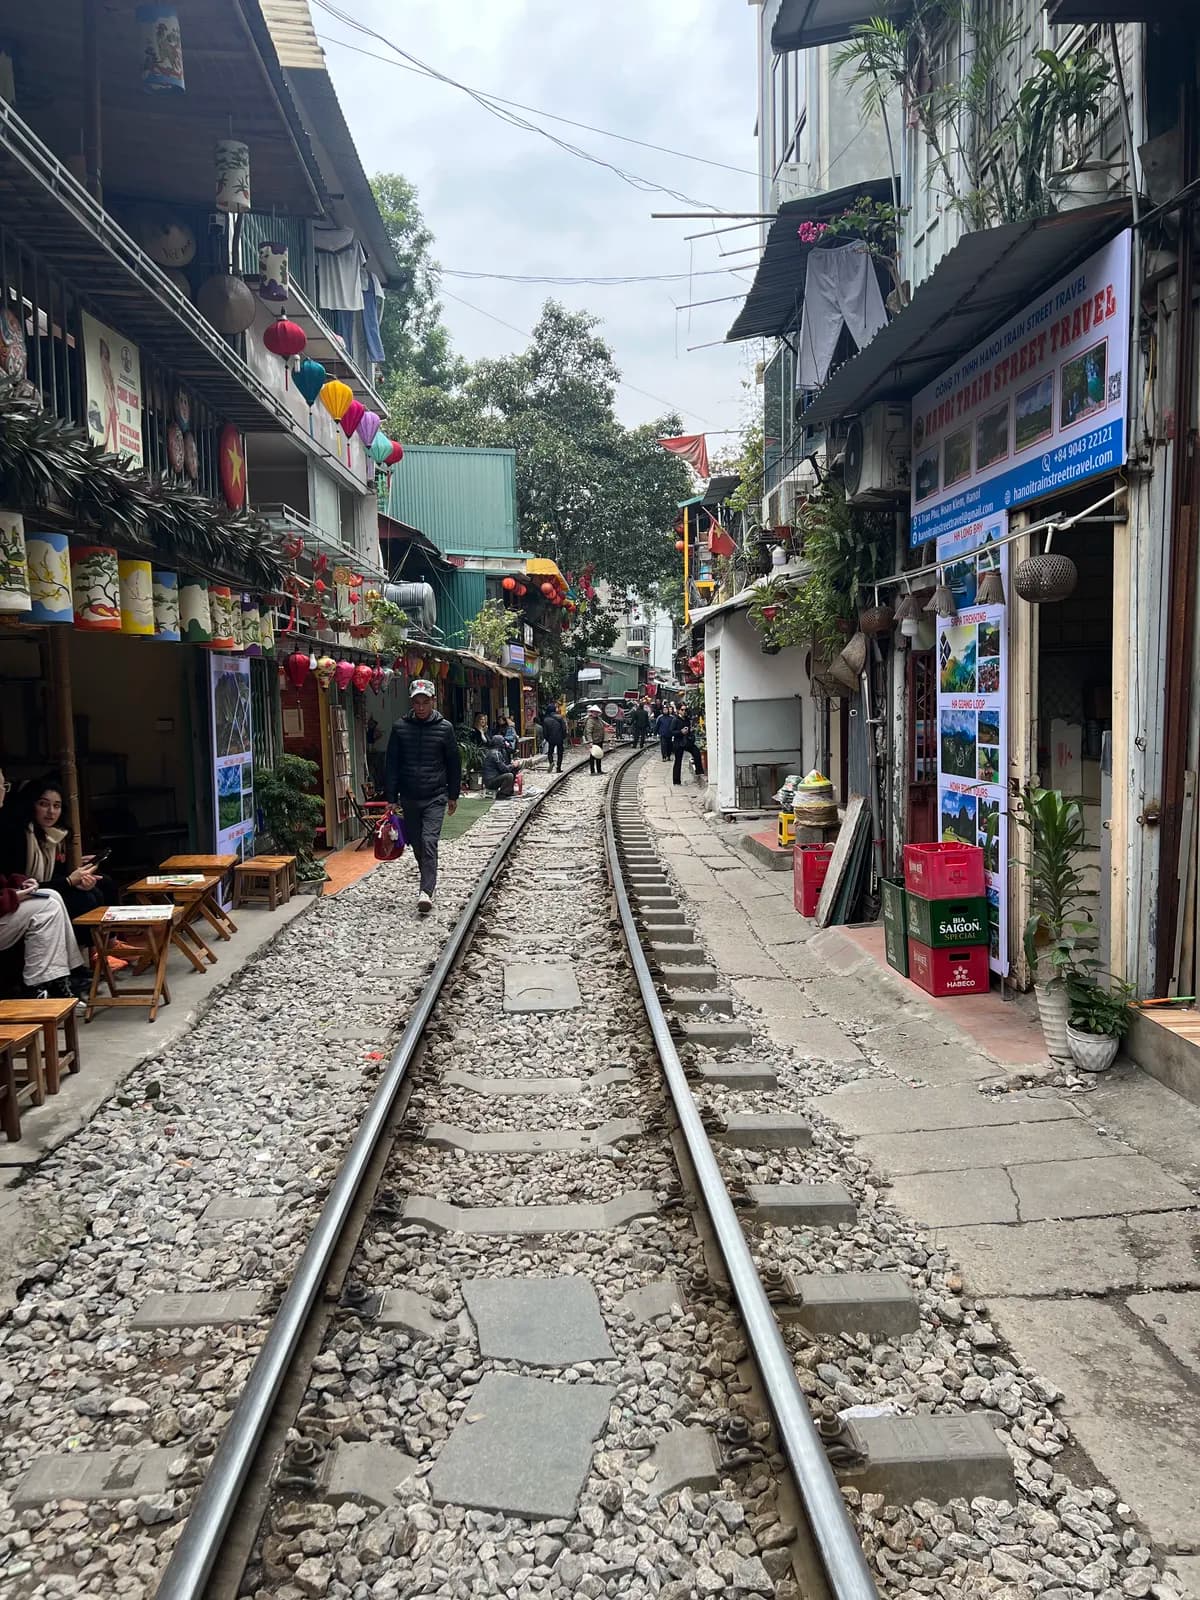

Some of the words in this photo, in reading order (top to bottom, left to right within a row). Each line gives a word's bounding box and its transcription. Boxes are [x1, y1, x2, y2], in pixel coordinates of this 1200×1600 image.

[980, 336, 1002, 366] HANOI
[1004, 321, 1025, 348] TRAIN
[1026, 300, 1053, 330] STREET
[1055, 275, 1087, 311] TRAVEL
[994, 330, 1048, 392] STREET
[1050, 284, 1116, 353] TRAVEL
[1054, 447, 1067, 463] +84
[1068, 438, 1086, 458] 9043
[1088, 426, 1112, 449] 22121
[1014, 450, 1113, 500] hanoitrainstreettravel.com
[954, 532, 960, 542] HA
[961, 525, 972, 539] LONG
[973, 700, 985, 709] LOOP
[939, 921, 980, 934] SAIGON
[944, 932, 976, 941] SPECIAL
[946, 980, 976, 989] HABECO
